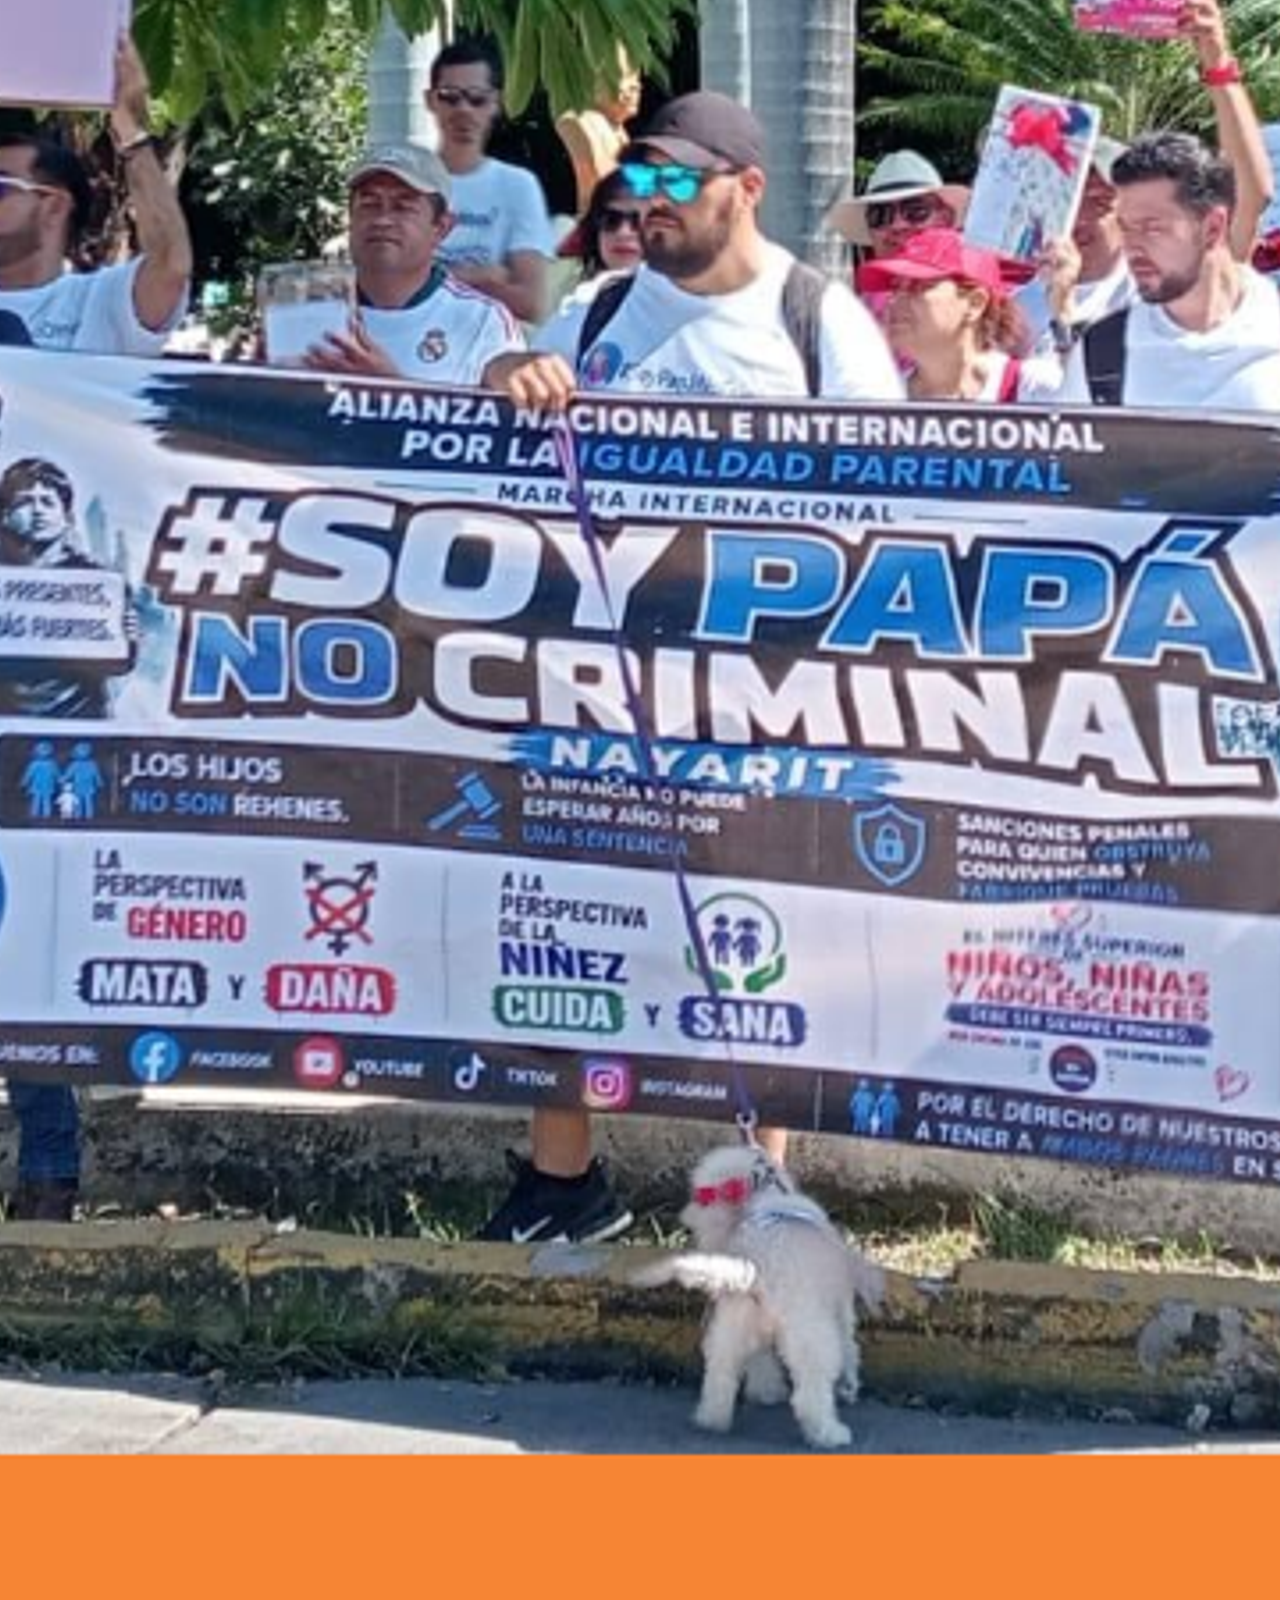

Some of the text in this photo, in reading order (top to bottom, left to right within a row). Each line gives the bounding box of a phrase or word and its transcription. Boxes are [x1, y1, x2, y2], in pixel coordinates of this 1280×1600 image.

[328, 388, 1105, 453] ALIANZA NACIONAL E INTERNACIONAL
[401, 430, 1072, 493] POR LA IGUALDAD PARENTAL
[496, 482, 897, 524] MARCHA INTERNACIONAL
[157, 492, 1268, 684] #SOY PAPÁ
[181, 611, 1262, 786] NO CRIMINAL
[131, 751, 284, 784] LOS HIJOS
[549, 735, 853, 792] NAYARIT
[129, 789, 351, 825] NO SON REHENES.
[522, 773, 546, 792] LA
[551, 775, 641, 801] INFANCIA
[679, 789, 747, 812] PUEDE
[522, 797, 613, 823] ESPERAR
[677, 814, 721, 835] POR
[956, 813, 1190, 842] SANCIONES PENALES
[93, 848, 122, 870] LA
[522, 824, 689, 856] UNA SENTENCIA
[956, 836, 1012, 859] PARA
[1017, 842, 1087, 862] QUIEN
[92, 874, 247, 901] PERSPECTIVA
[500, 870, 544, 893] A LA
[956, 859, 1147, 883] CONVIVENCIAS Y
[92, 902, 247, 942] DE GÉNERO
[498, 918, 556, 942] DE LA
[499, 893, 649, 930] PERSPECTIVA
[499, 940, 629, 984] NIÑEZ
[1082, 933, 1185, 959] SUPERIOR
[91, 963, 383, 1012] MATA Y DAÑA
[1090, 960, 1210, 997] NIÑAS
[503, 990, 794, 1044] CUIDA Y SANA
[947, 979, 1210, 1022] Y ADOLESCENTES
[354, 1057, 424, 1079] YOUTUBE
[507, 1066, 559, 1087] TIKTOK
[640, 1078, 728, 1100] INSTAGRAM
[916, 1090, 966, 1118] POR
[970, 1095, 997, 1121] EL
[1002, 1100, 1115, 1133] DERECHO
[1121, 1112, 1150, 1138] DE
[915, 1119, 931, 1141] A
[937, 1121, 1011, 1150] TENER
[1016, 1131, 1034, 1152] A
[1232, 1155, 1267, 1177] EN
